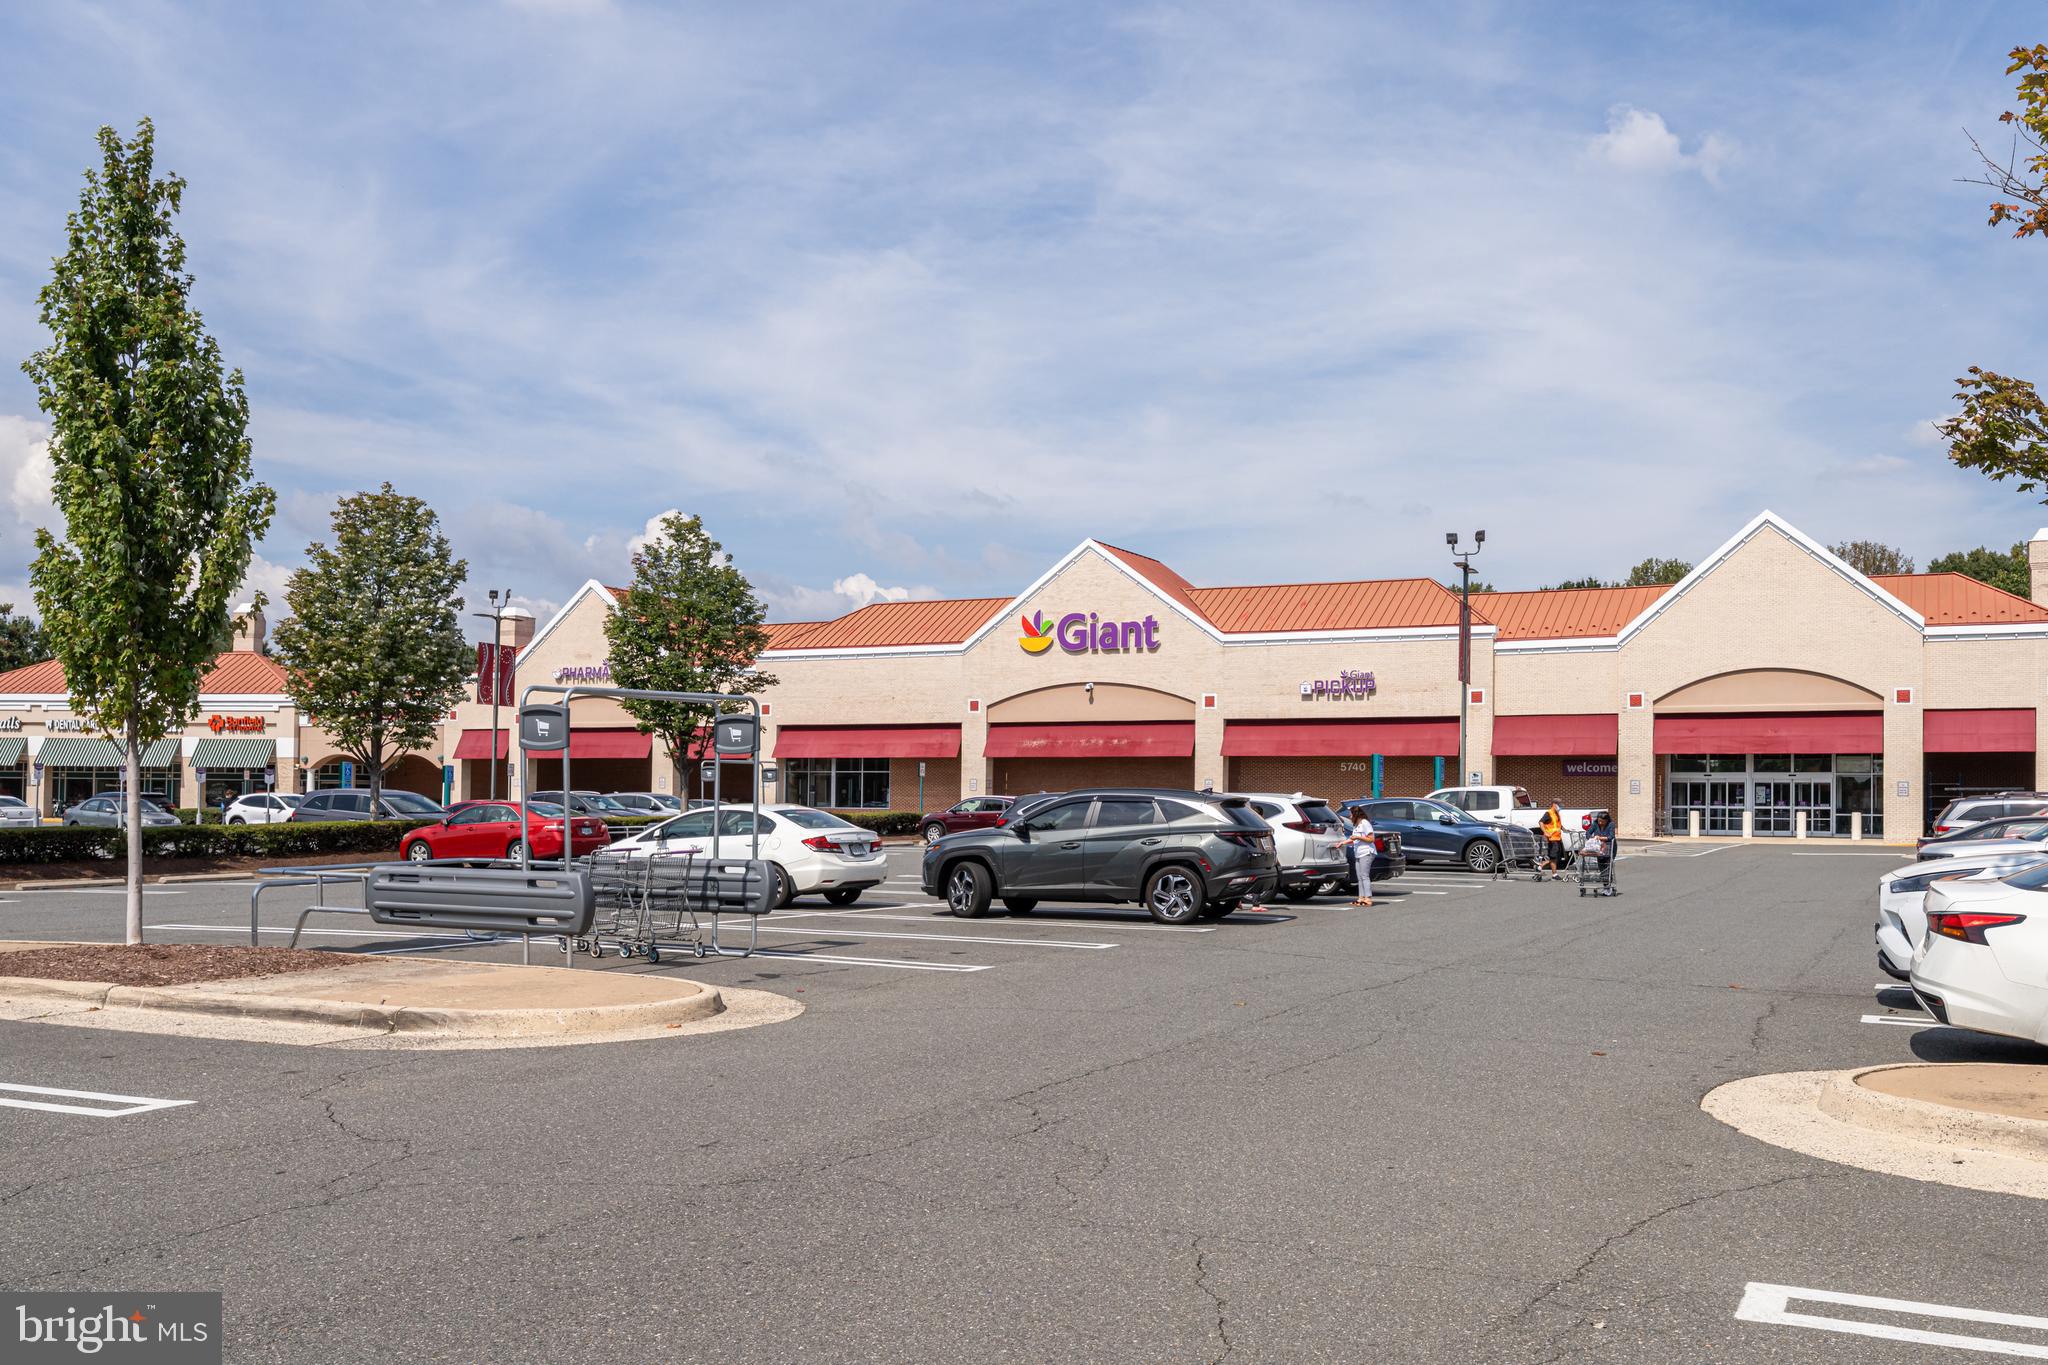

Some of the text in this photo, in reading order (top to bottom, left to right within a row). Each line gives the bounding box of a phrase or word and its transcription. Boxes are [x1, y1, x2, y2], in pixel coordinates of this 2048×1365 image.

[1056, 611, 1160, 651] Giant
[562, 667, 610, 679] PHARMA
[1349, 669, 1374, 679] Giant
[1314, 679, 1376, 694] PICKUP
[55, 719, 80, 730] DENTAL
[1340, 762, 1366, 772] 5740
[1566, 762, 1618, 773] welcome
